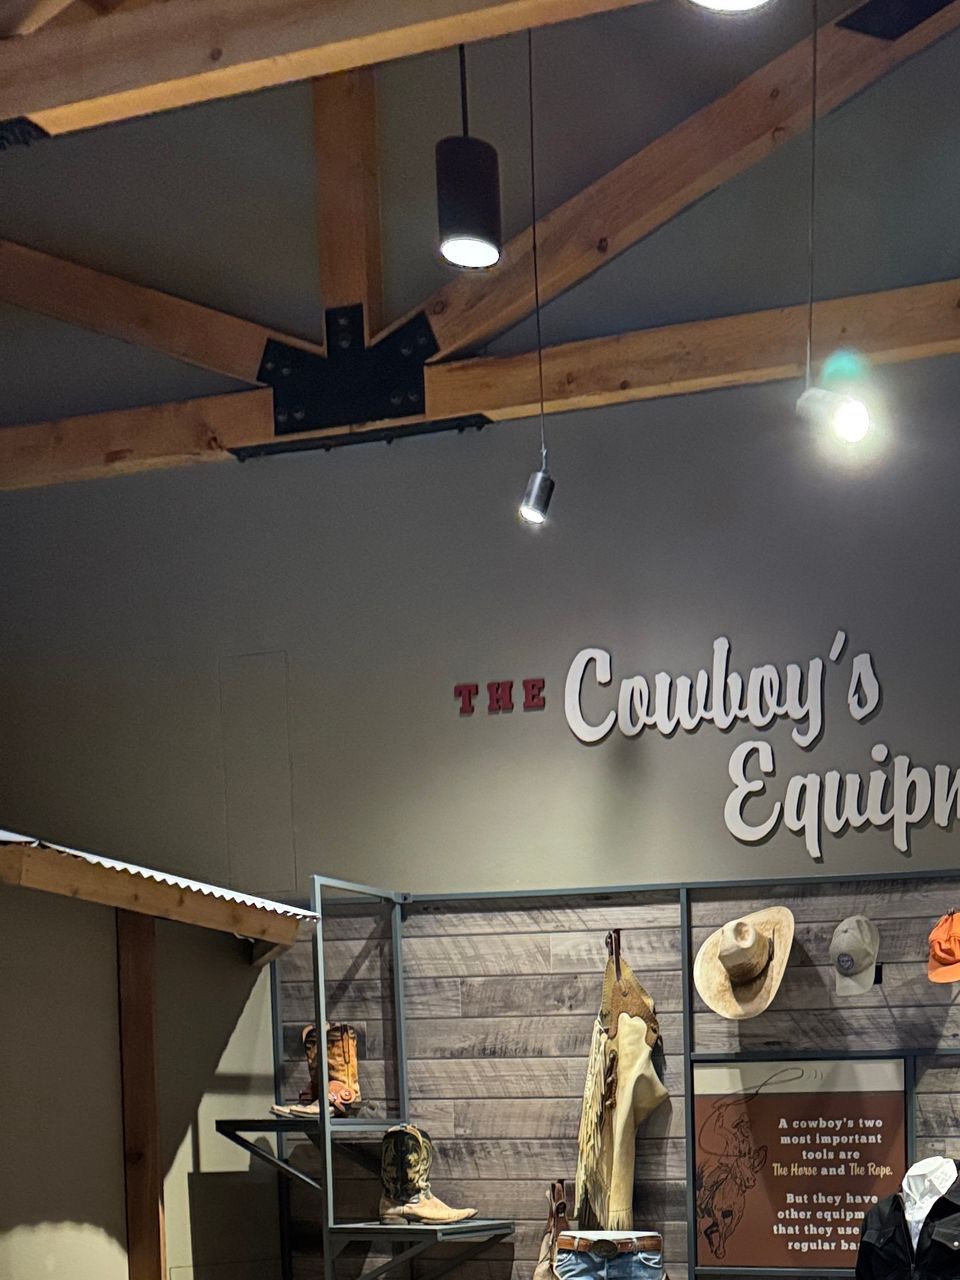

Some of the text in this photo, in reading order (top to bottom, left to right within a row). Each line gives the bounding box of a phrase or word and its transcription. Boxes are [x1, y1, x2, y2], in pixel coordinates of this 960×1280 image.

[453, 630, 881, 749] THE Cowboy's
[778, 1117, 883, 1130] A cowboy's two
[780, 1133, 883, 1146] most important
[802, 1149, 860, 1160] tools are
[772, 1162, 893, 1178] The Horse and The Rope.
[786, 1193, 878, 1206] But they have
[778, 1208, 812, 1219] other
[773, 1224, 860, 1236] that they use
[788, 1240, 860, 1252] regular ba
